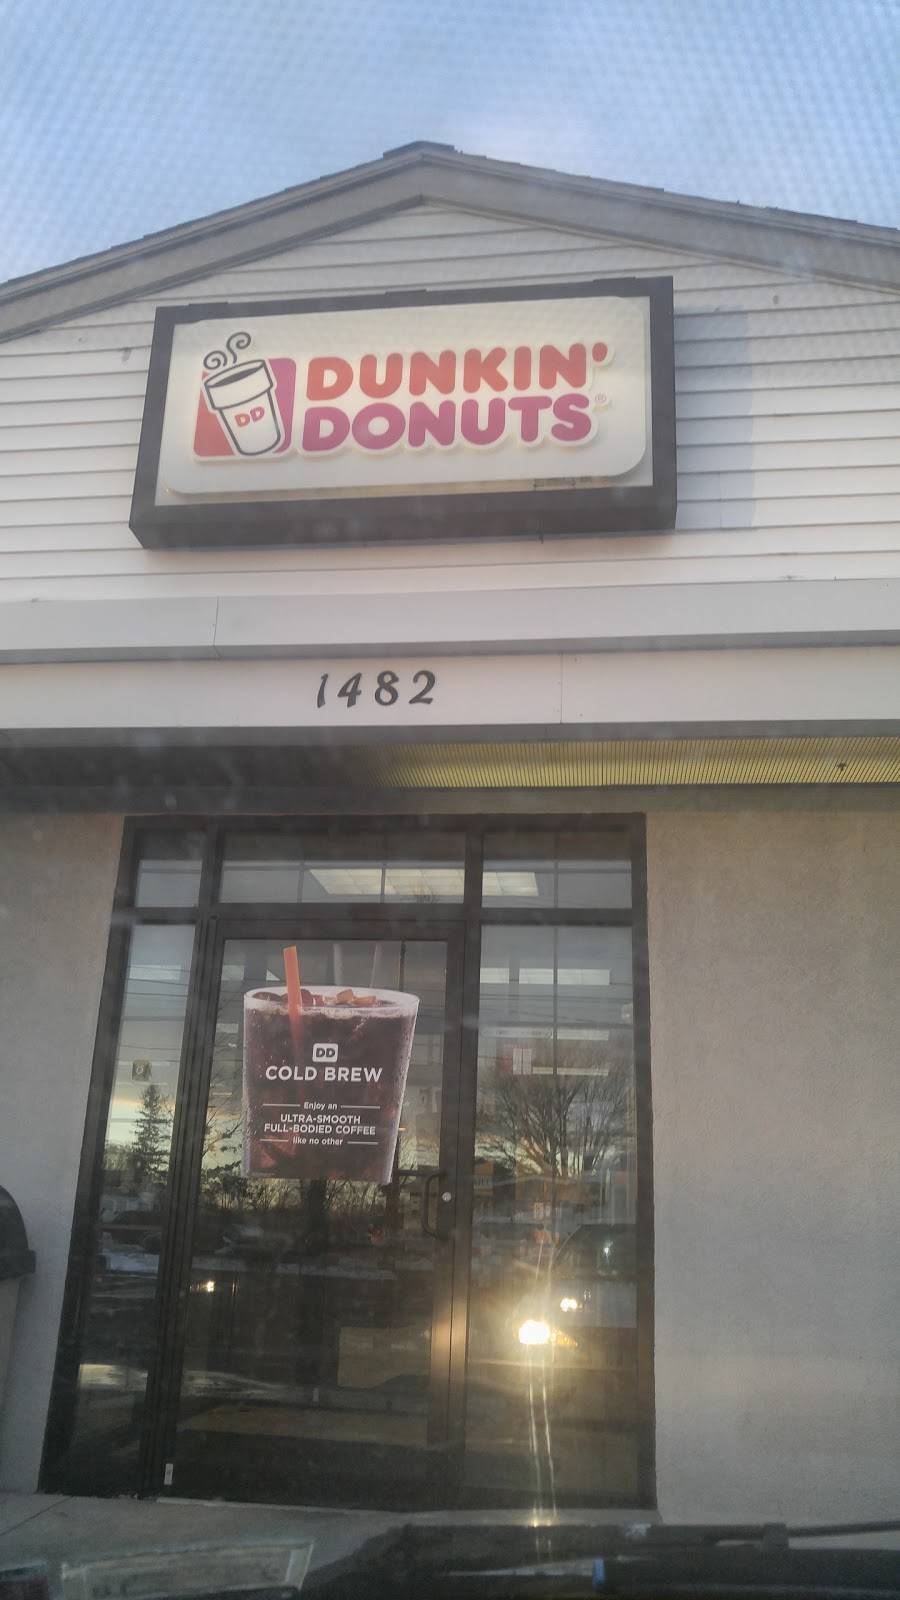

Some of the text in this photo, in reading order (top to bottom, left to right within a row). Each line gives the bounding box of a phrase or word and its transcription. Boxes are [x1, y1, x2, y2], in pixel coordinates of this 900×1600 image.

[306, 342, 608, 401] DUNKIN'
[235, 406, 265, 427] DD
[302, 393, 592, 451] DONUTS
[317, 670, 436, 708] 1482
[315, 1047, 336, 1058] DD
[265, 1066, 383, 1082] COLD BREW
[303, 1102, 326, 1111] Enjoy
[280, 1113, 361, 1124] ULTRA-SMOOTH
[264, 1123, 376, 1135] FULL-BODIED COFFEE
[292, 1136, 344, 1146] like no other
